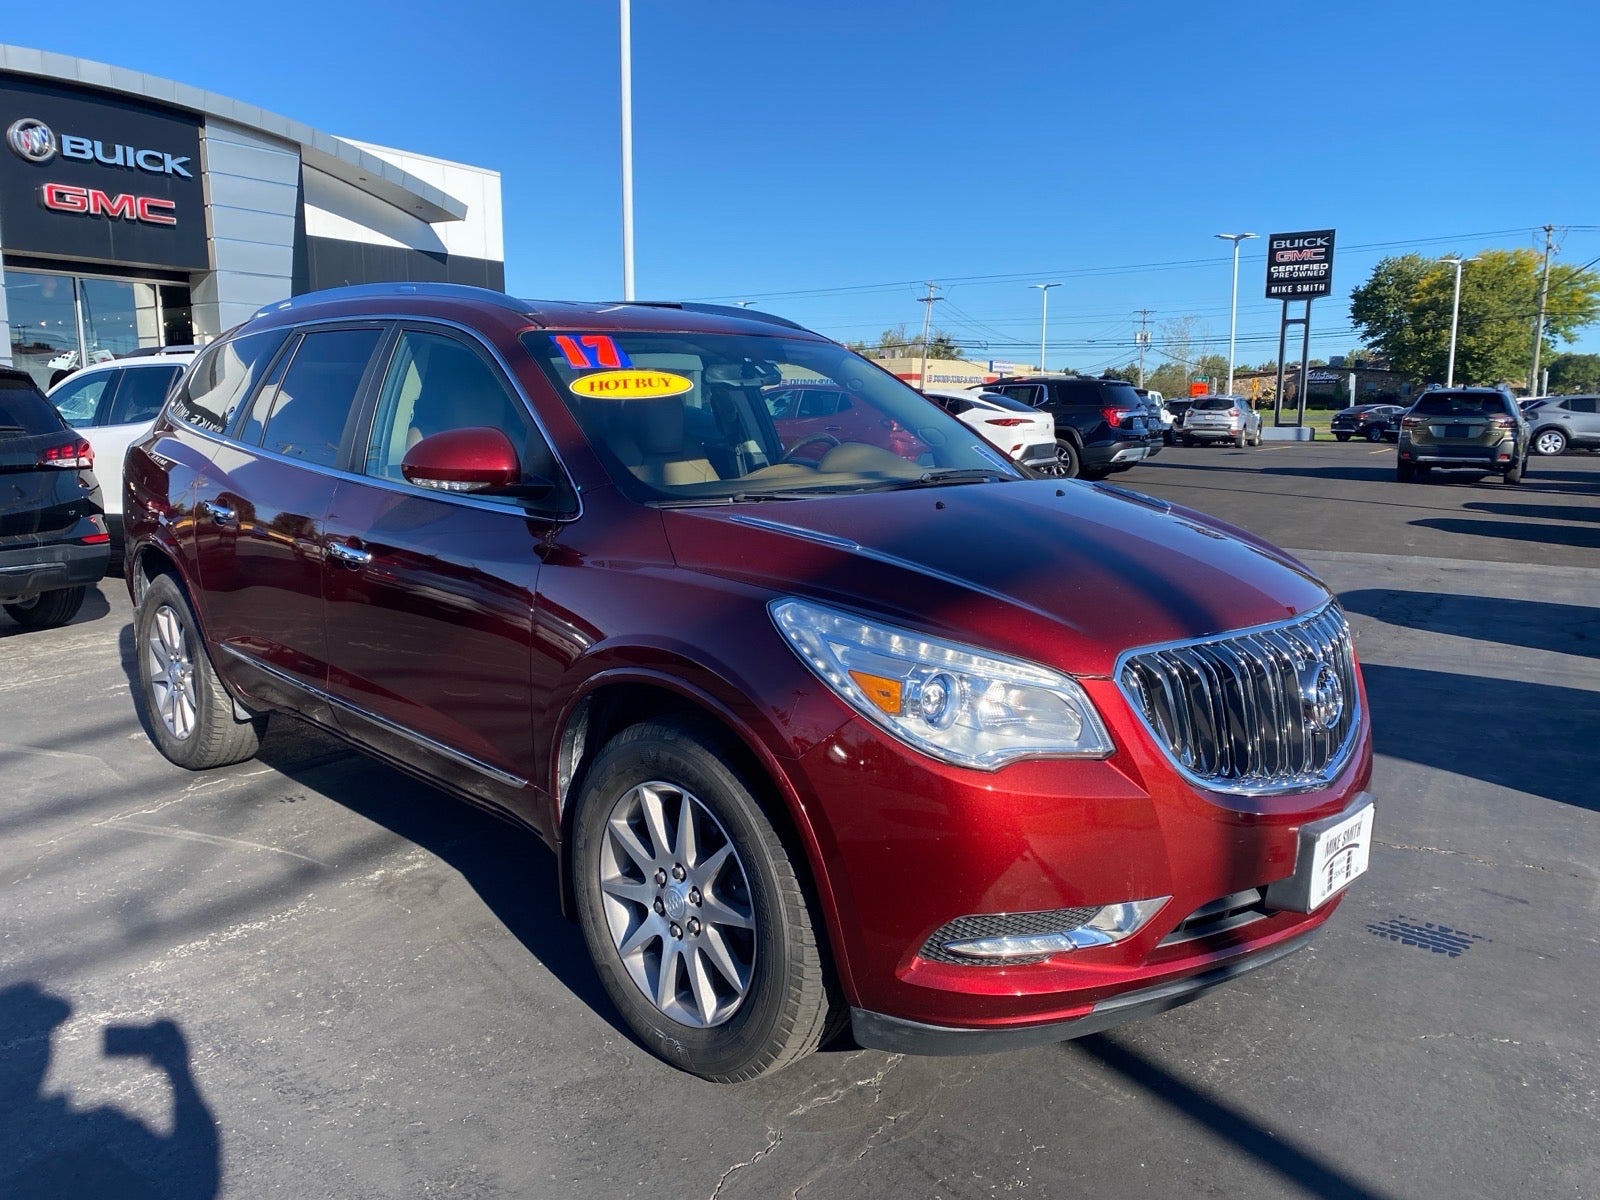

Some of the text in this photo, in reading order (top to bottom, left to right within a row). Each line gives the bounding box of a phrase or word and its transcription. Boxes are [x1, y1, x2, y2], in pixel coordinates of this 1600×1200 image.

[62, 134, 193, 177] BUICK
[43, 182, 177, 225] GMC
[1273, 236, 1330, 249] BUICK
[1275, 248, 1326, 262] GMC
[1270, 263, 1329, 272] CERTIFIED
[1273, 270, 1325, 278] PRE-OWNED
[1271, 284, 1325, 293] MIKE SMITH
[555, 335, 622, 368] 17
[589, 377, 672, 392] HOT BUY
[1325, 821, 1362, 859] MIKE SMITH
